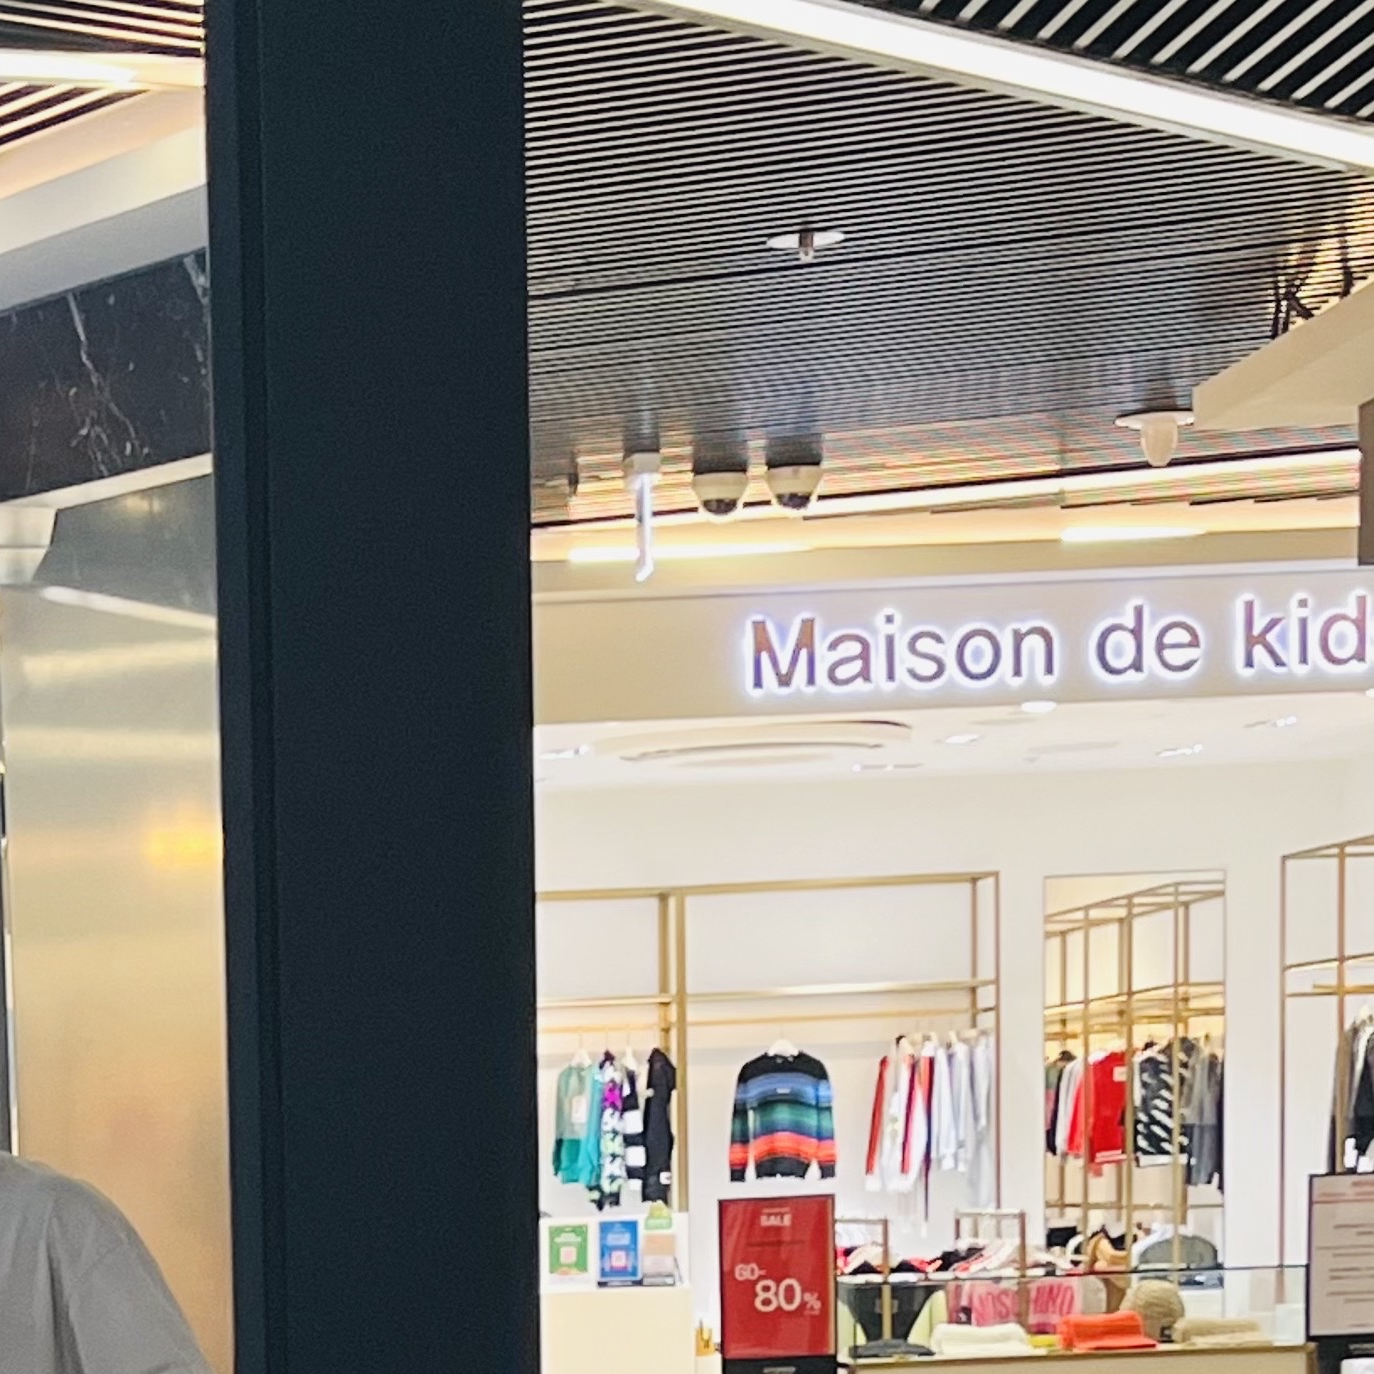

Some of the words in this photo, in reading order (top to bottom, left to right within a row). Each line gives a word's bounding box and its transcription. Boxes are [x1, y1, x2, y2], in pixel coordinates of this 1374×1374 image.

[749, 608, 1058, 691] Maison
[1088, 603, 1203, 676] de
[1240, 592, 1370, 669] kid
[760, 1213, 792, 1227] SALE
[754, 1278, 823, 1313] 80%
